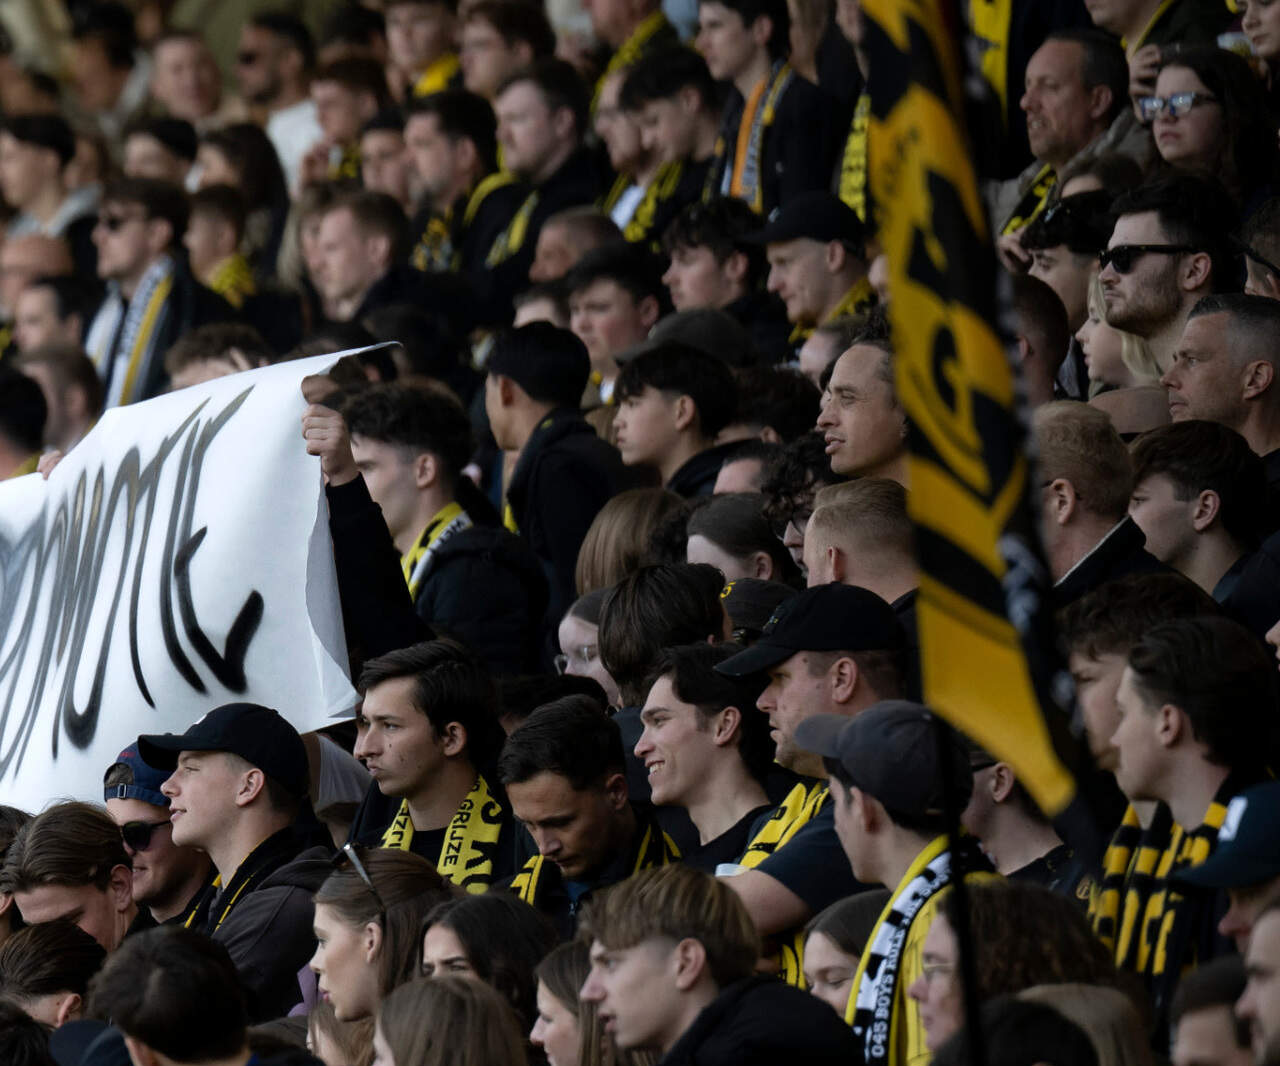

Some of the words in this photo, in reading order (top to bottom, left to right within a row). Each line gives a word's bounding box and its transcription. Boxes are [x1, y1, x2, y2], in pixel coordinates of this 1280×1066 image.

[443, 799, 474, 867] GRIJZE
[875, 972, 895, 1020] BOYS
[870, 1020, 889, 1060] 045
